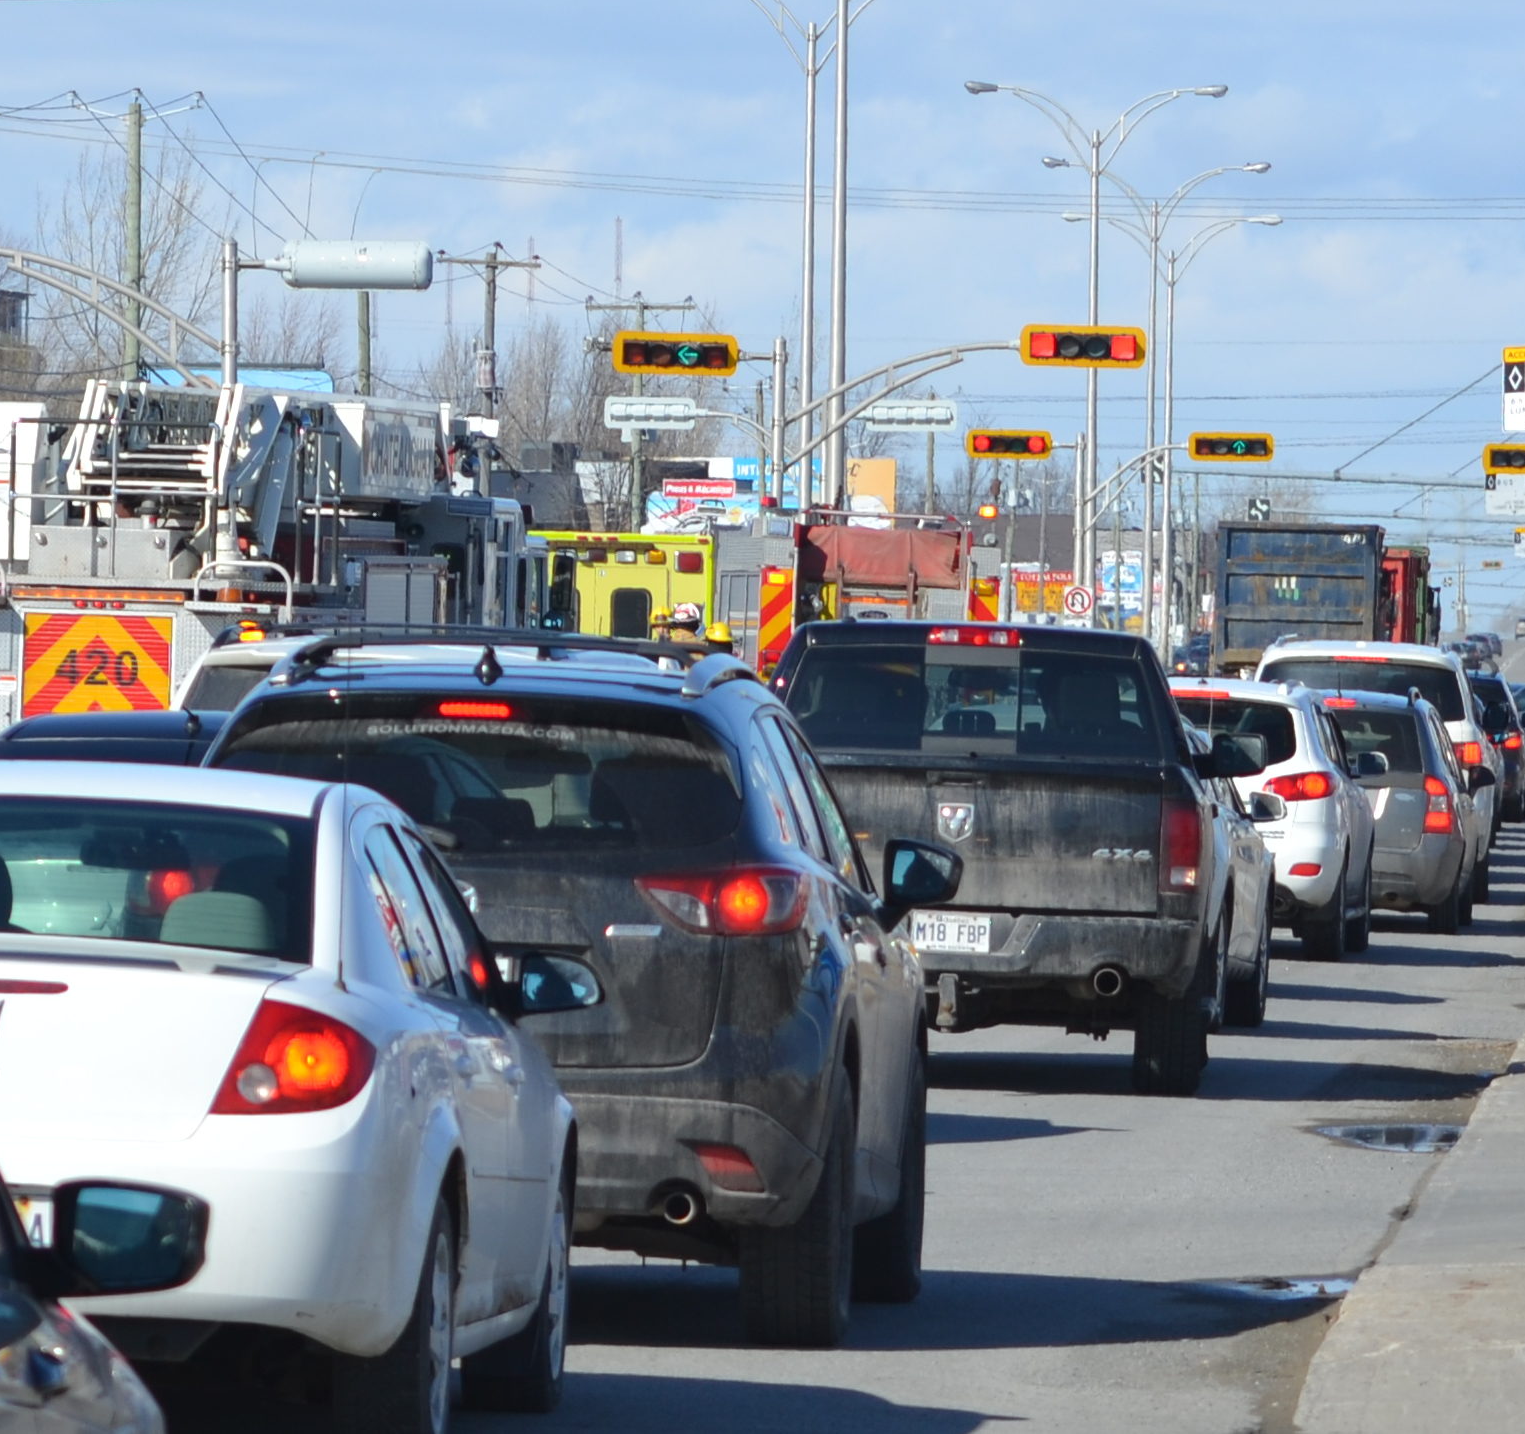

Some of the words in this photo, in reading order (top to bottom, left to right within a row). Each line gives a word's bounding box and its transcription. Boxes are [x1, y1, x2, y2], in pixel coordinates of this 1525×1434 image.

[54, 648, 139, 687] 420
[366, 721, 577, 742] SOLUTIONMAZDA.COM
[916, 922, 947, 942] M18
[956, 924, 987, 944] FBP
